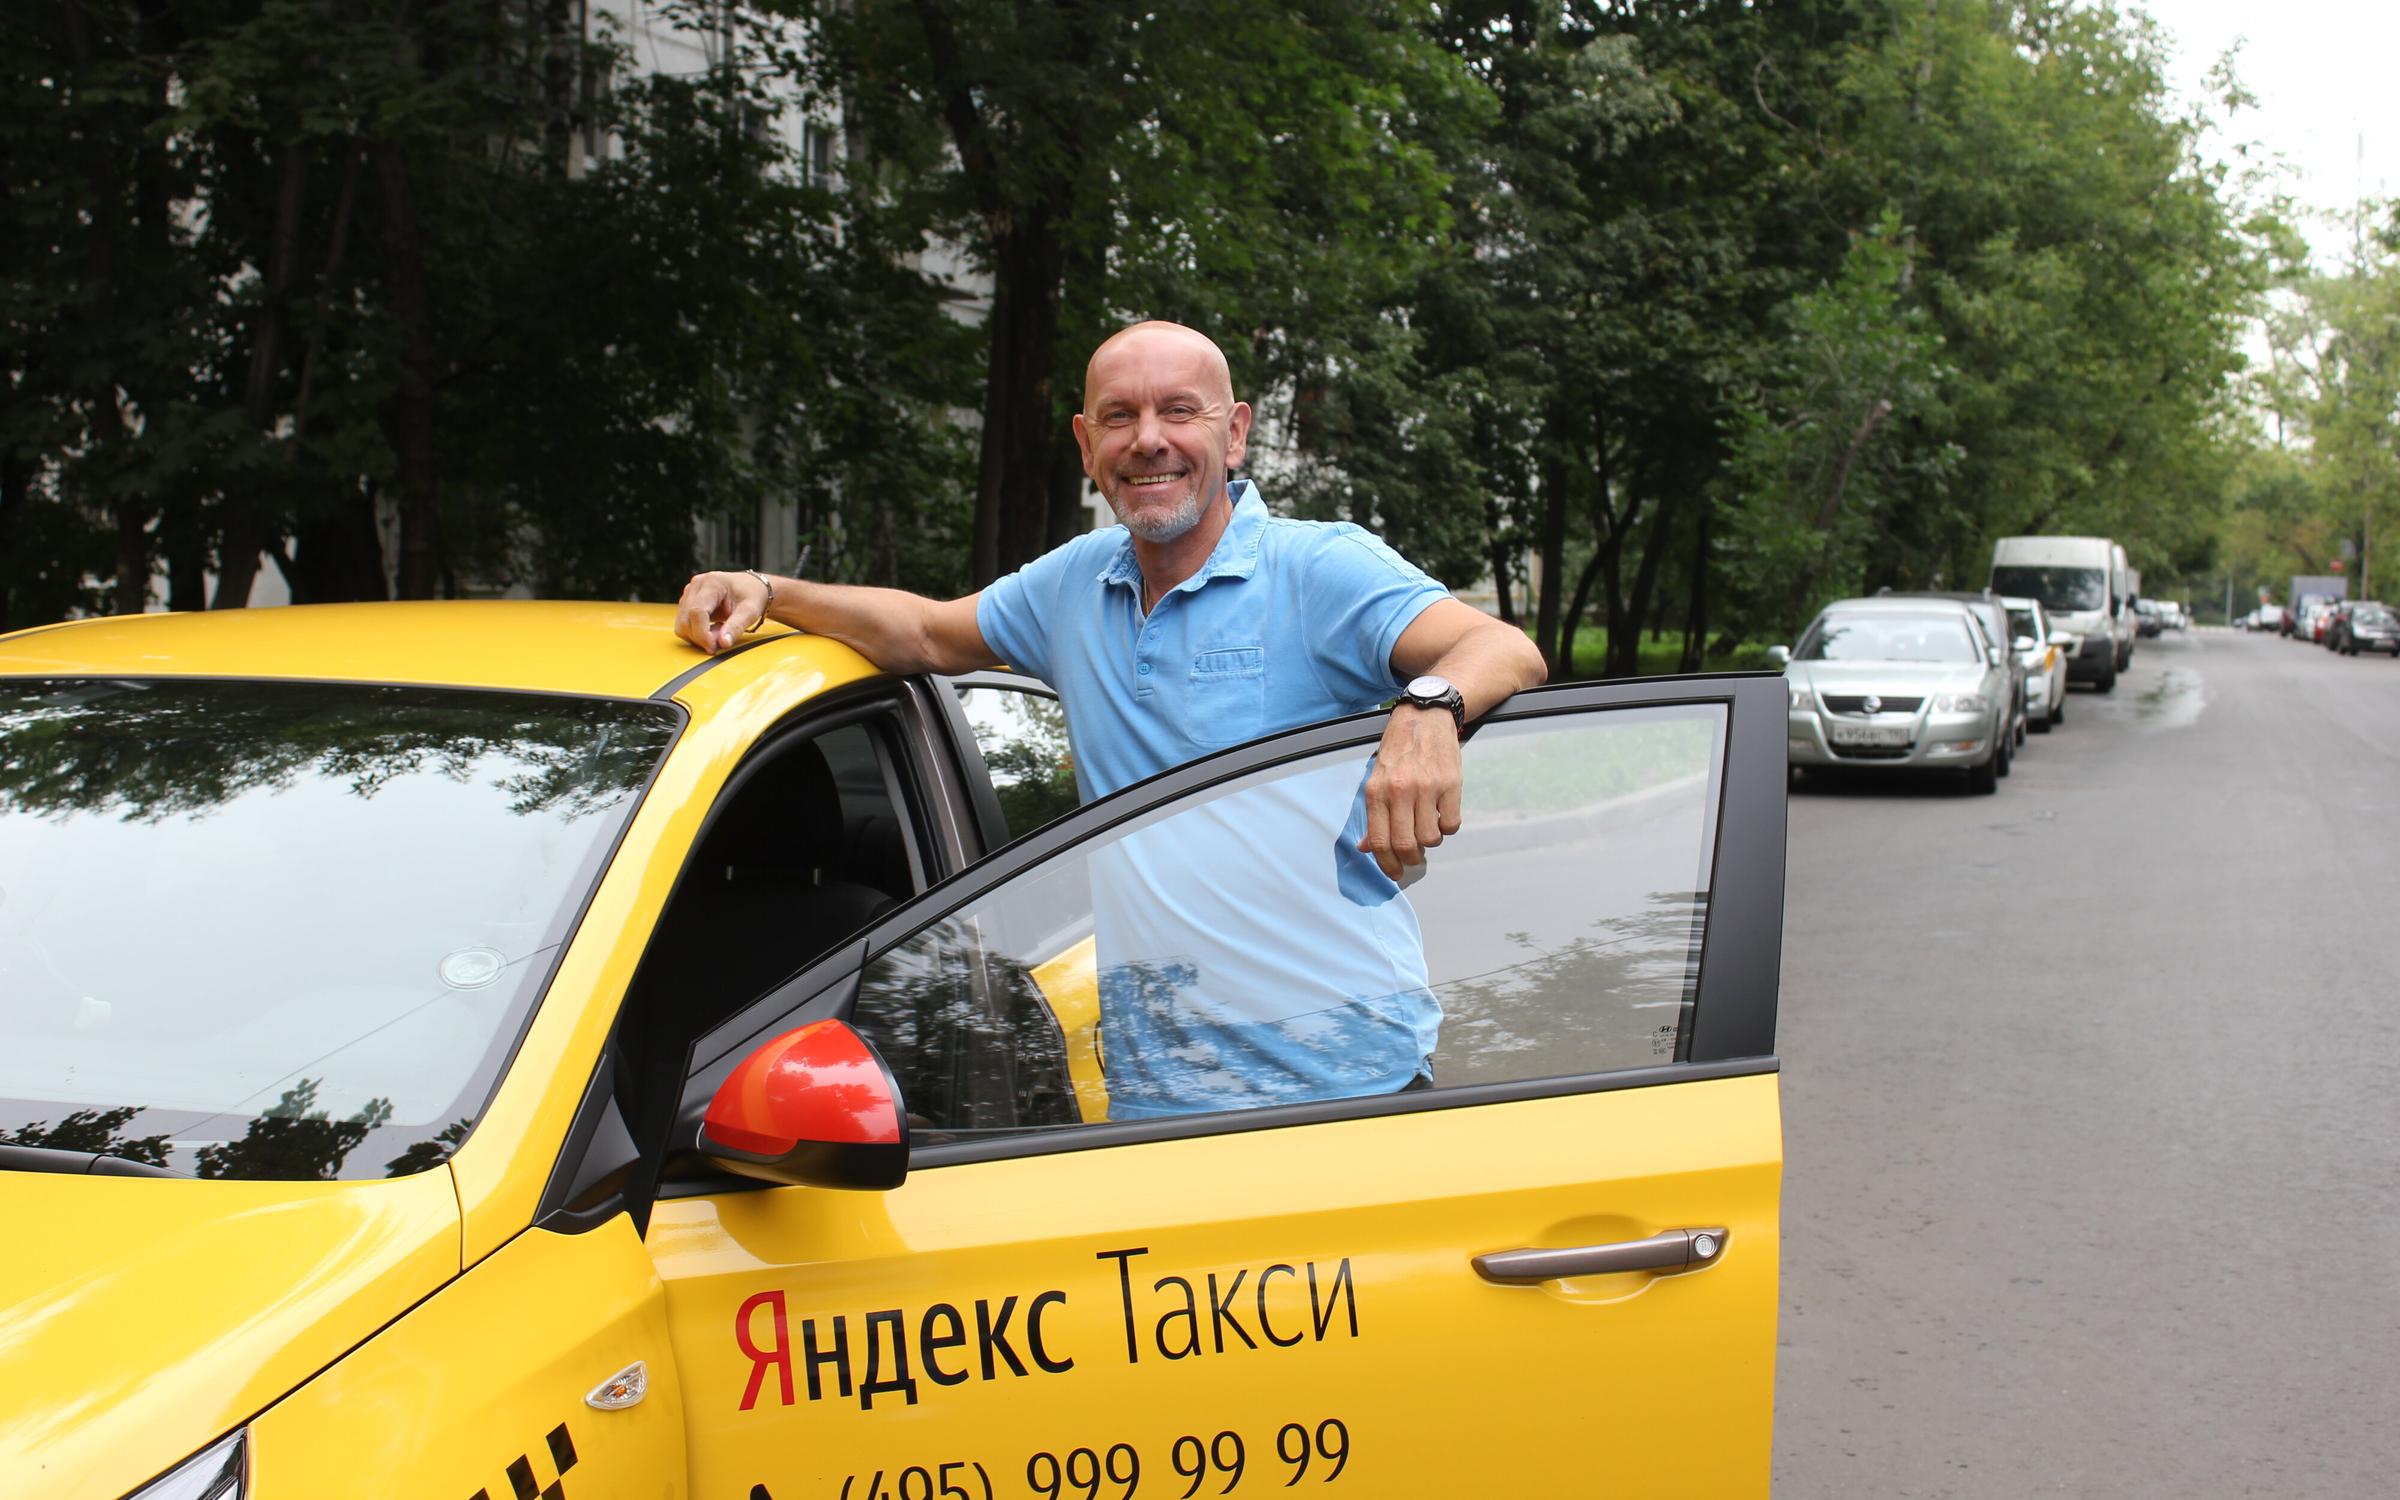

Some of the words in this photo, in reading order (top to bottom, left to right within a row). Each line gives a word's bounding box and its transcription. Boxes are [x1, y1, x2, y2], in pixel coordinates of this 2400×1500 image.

[735, 1289, 1075, 1411] Яндекс
[1096, 1246, 1359, 1364] Такси
[1026, 1442, 1140, 1500] 999
[1171, 1430, 1246, 1500] 99
[1276, 1418, 1350, 1488] 99
